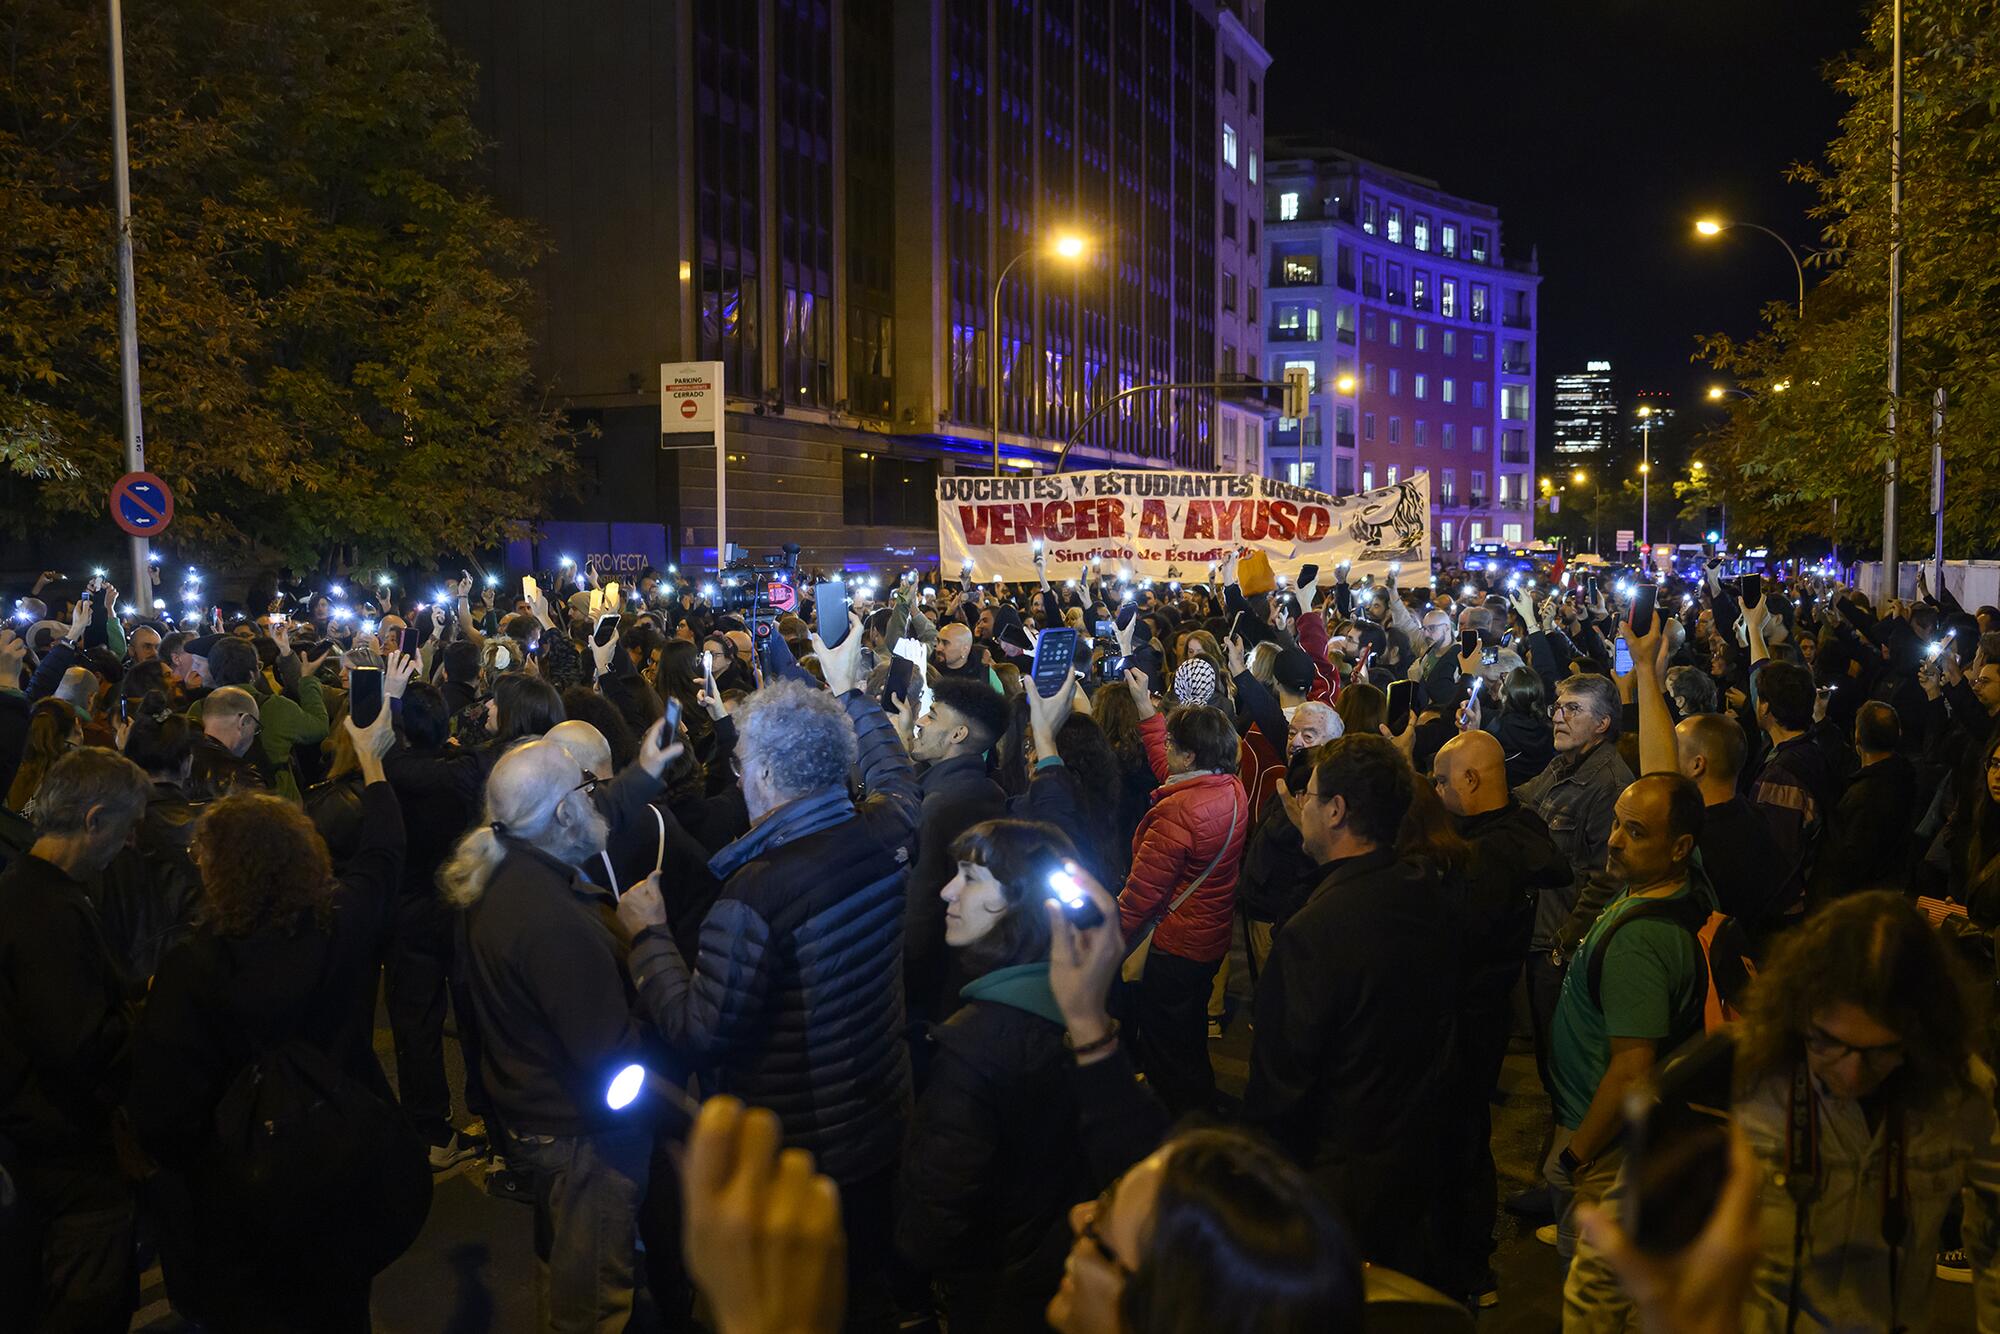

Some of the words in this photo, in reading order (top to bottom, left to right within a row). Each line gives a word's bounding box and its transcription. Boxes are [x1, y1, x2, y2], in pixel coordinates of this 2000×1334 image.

[673, 391, 704, 399] CERRADO
[939, 477, 1063, 502] DOCENTES
[1070, 475, 1087, 497] Y
[1094, 471, 1253, 498] ESTUDIANTES
[958, 498, 1126, 546] VENCER
[1138, 499, 1170, 540] A
[1183, 499, 1331, 543] AYUSO
[587, 553, 649, 571] PROYECTA
[1055, 547, 1134, 563] Sindicato
[1137, 548, 1162, 561] de
